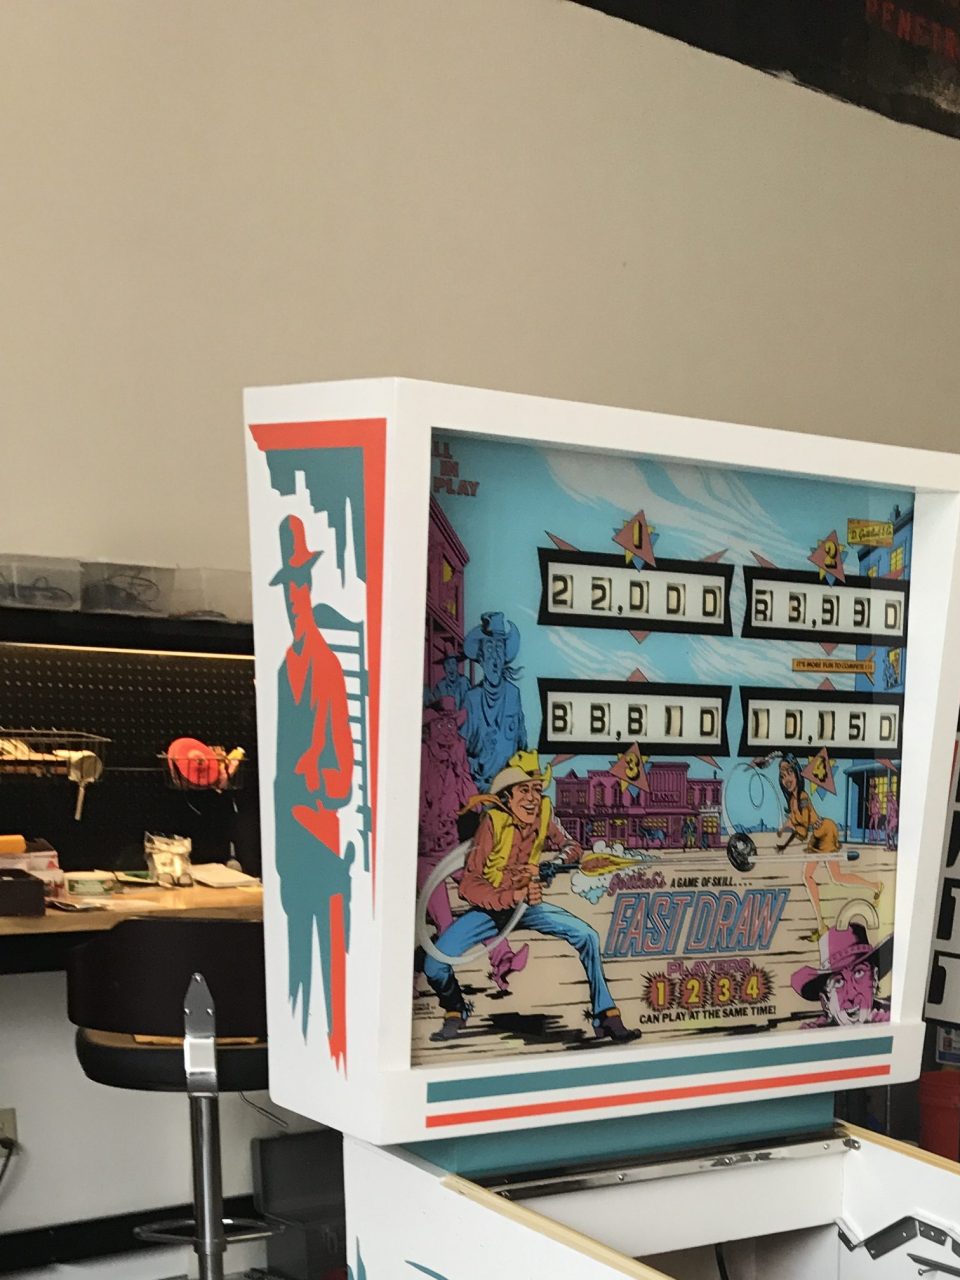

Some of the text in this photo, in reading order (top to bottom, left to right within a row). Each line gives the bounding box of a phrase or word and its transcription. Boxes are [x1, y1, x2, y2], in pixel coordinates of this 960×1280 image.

[440, 460, 459, 478] IN
[433, 476, 480, 496] PLAY
[824, 541, 838, 569] 2
[625, 753, 640, 779] 3
[812, 759, 829, 783] 4
[670, 878, 676, 888] A
[677, 876, 699, 888] GAME
[701, 876, 712, 887] OF
[603, 887, 791, 958] FAST DRAW
[667, 957, 751, 977] PLAYERS
[656, 975, 760, 1006] 1 2 3 4
[639, 1005, 777, 1024] CAN PLAY AT THE SAME TIME!
